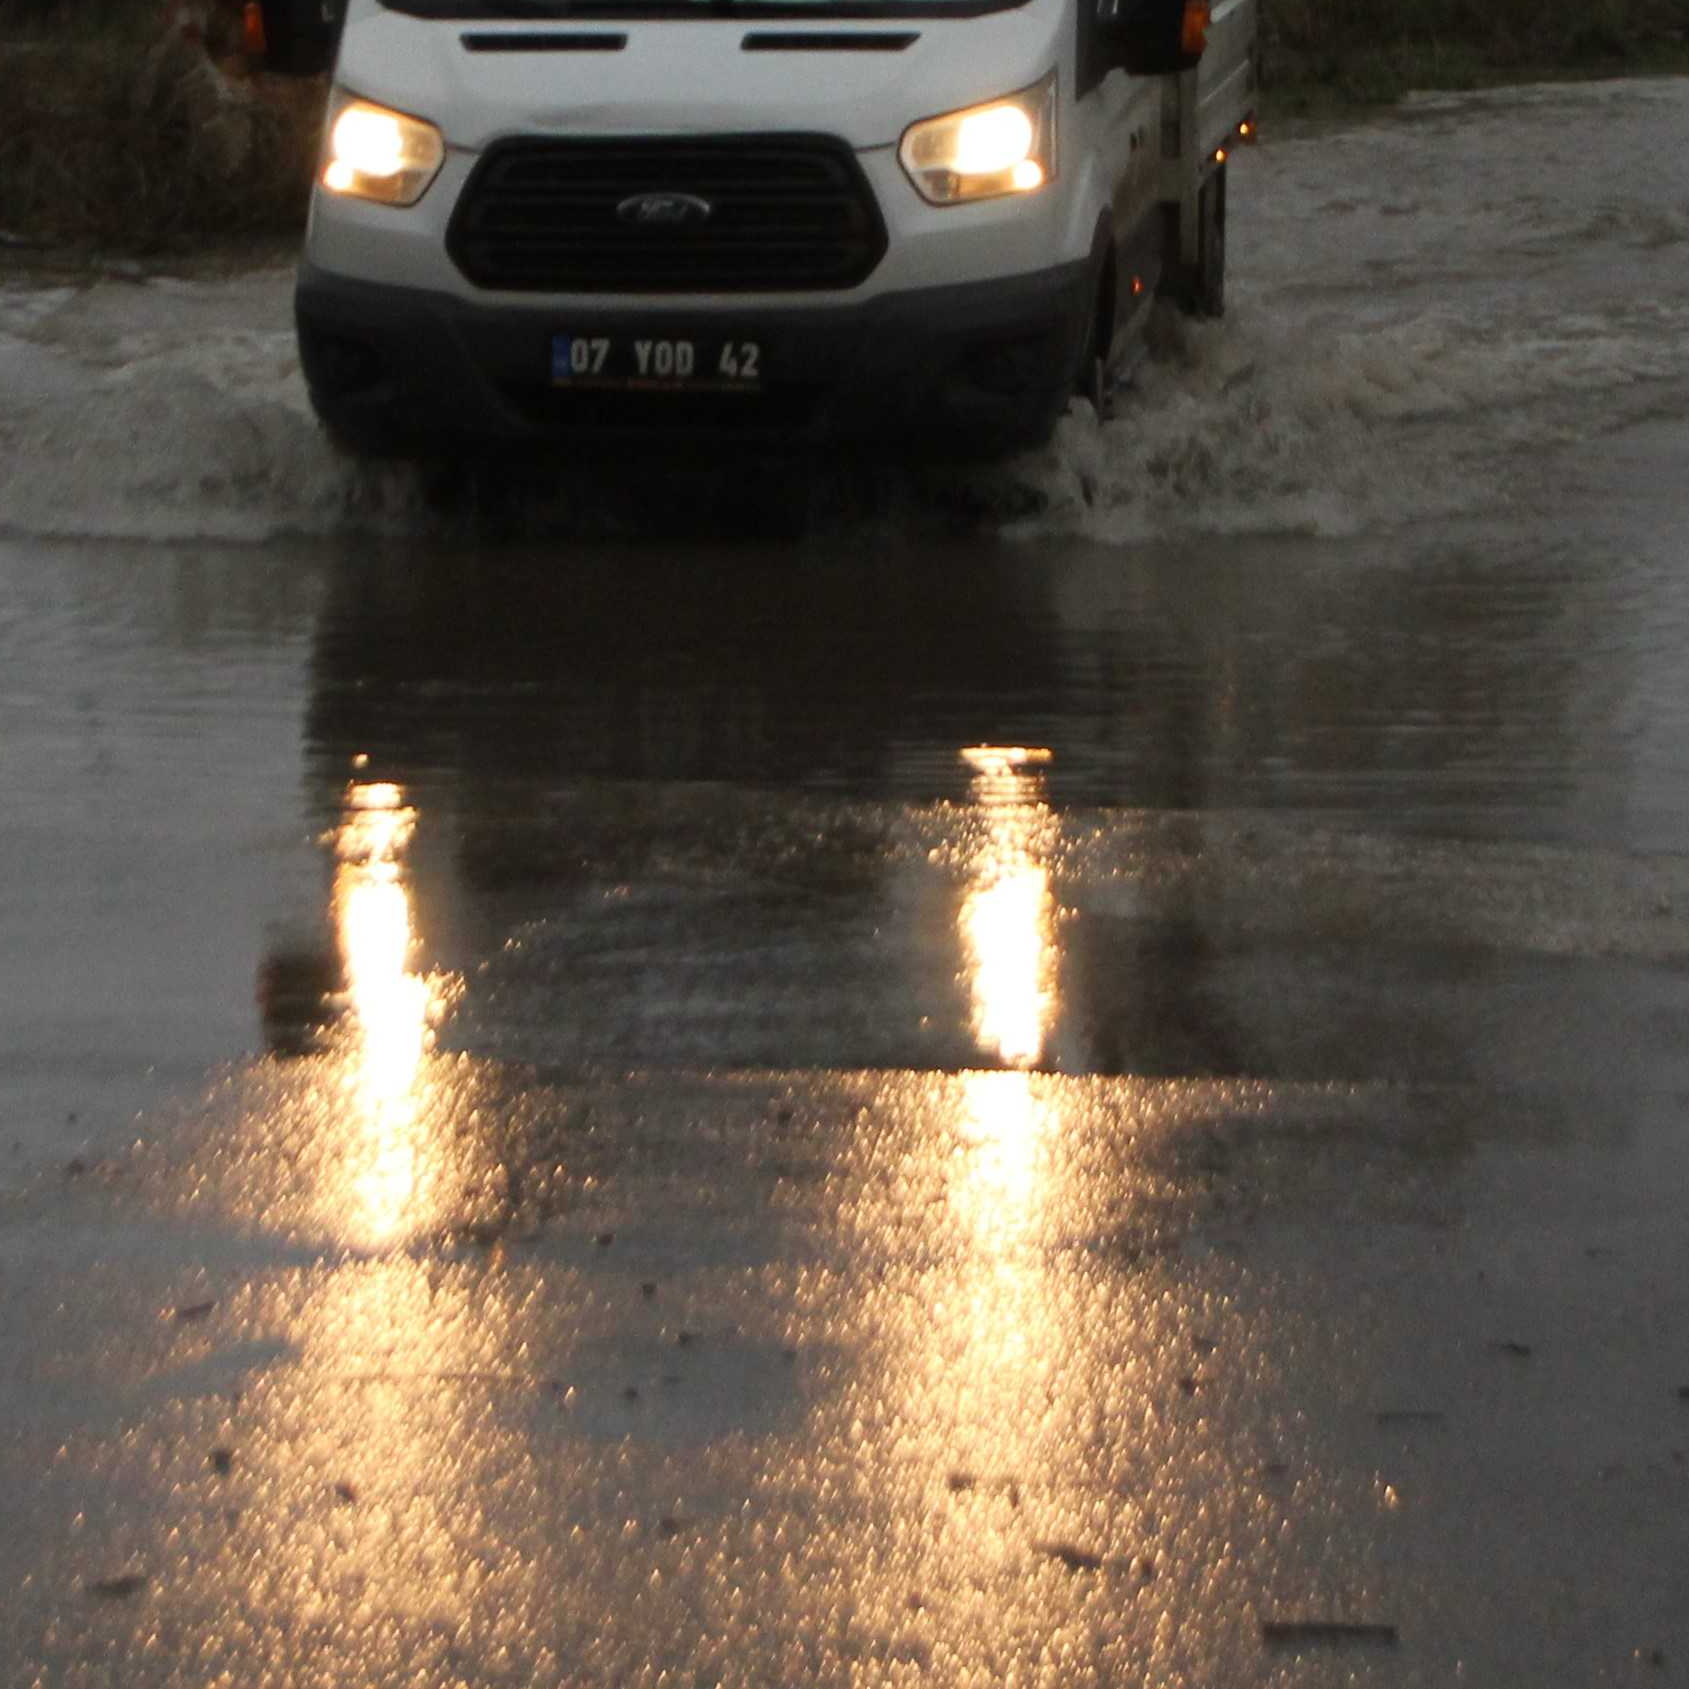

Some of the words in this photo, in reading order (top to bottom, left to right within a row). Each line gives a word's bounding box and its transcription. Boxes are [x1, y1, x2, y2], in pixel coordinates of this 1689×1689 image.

[570, 337, 611, 374] 07
[633, 339, 696, 376] YOD
[718, 341, 760, 378] 42
